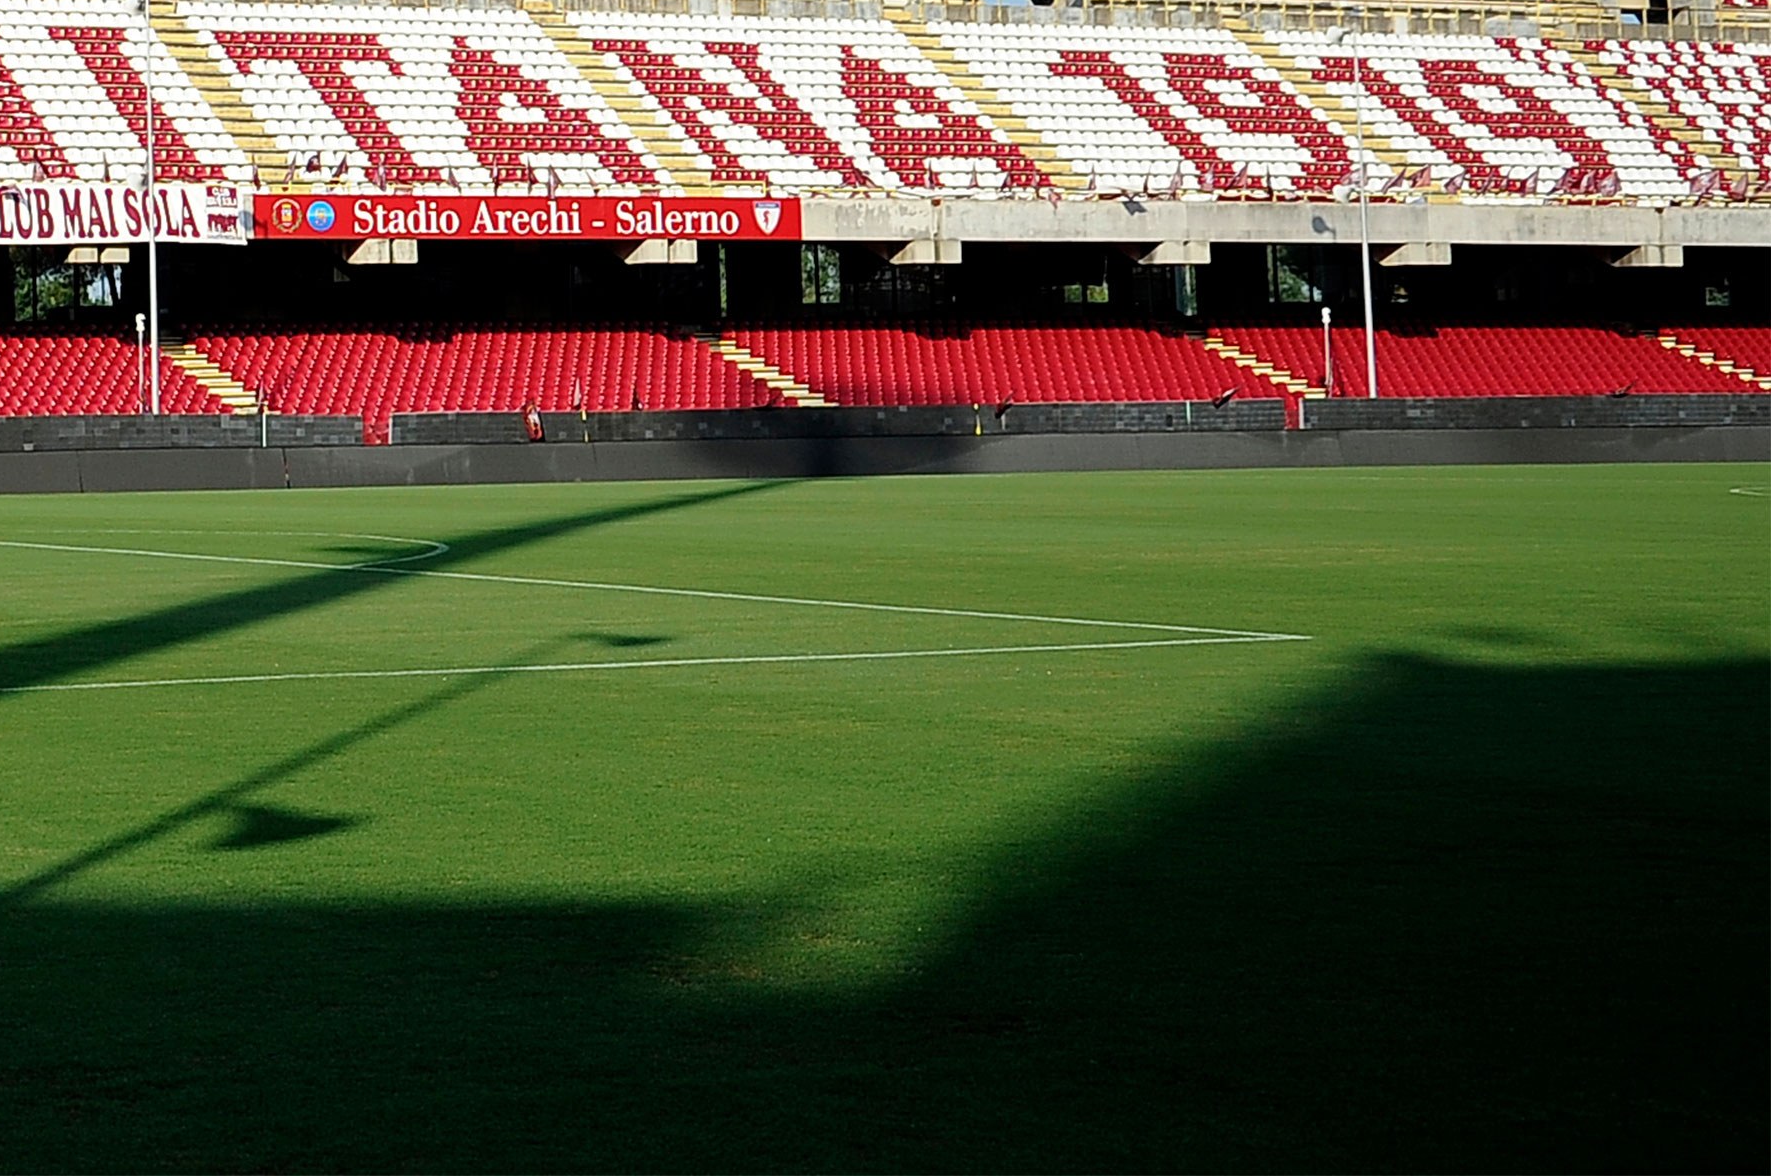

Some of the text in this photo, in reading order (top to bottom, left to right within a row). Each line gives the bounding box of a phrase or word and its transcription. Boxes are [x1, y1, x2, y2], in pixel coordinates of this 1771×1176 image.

[59, 187, 119, 239] MAI
[123, 187, 201, 238] SOLA
[353, 199, 460, 235] Stadio
[470, 200, 582, 235] Arechi
[616, 201, 740, 236] Salerno
